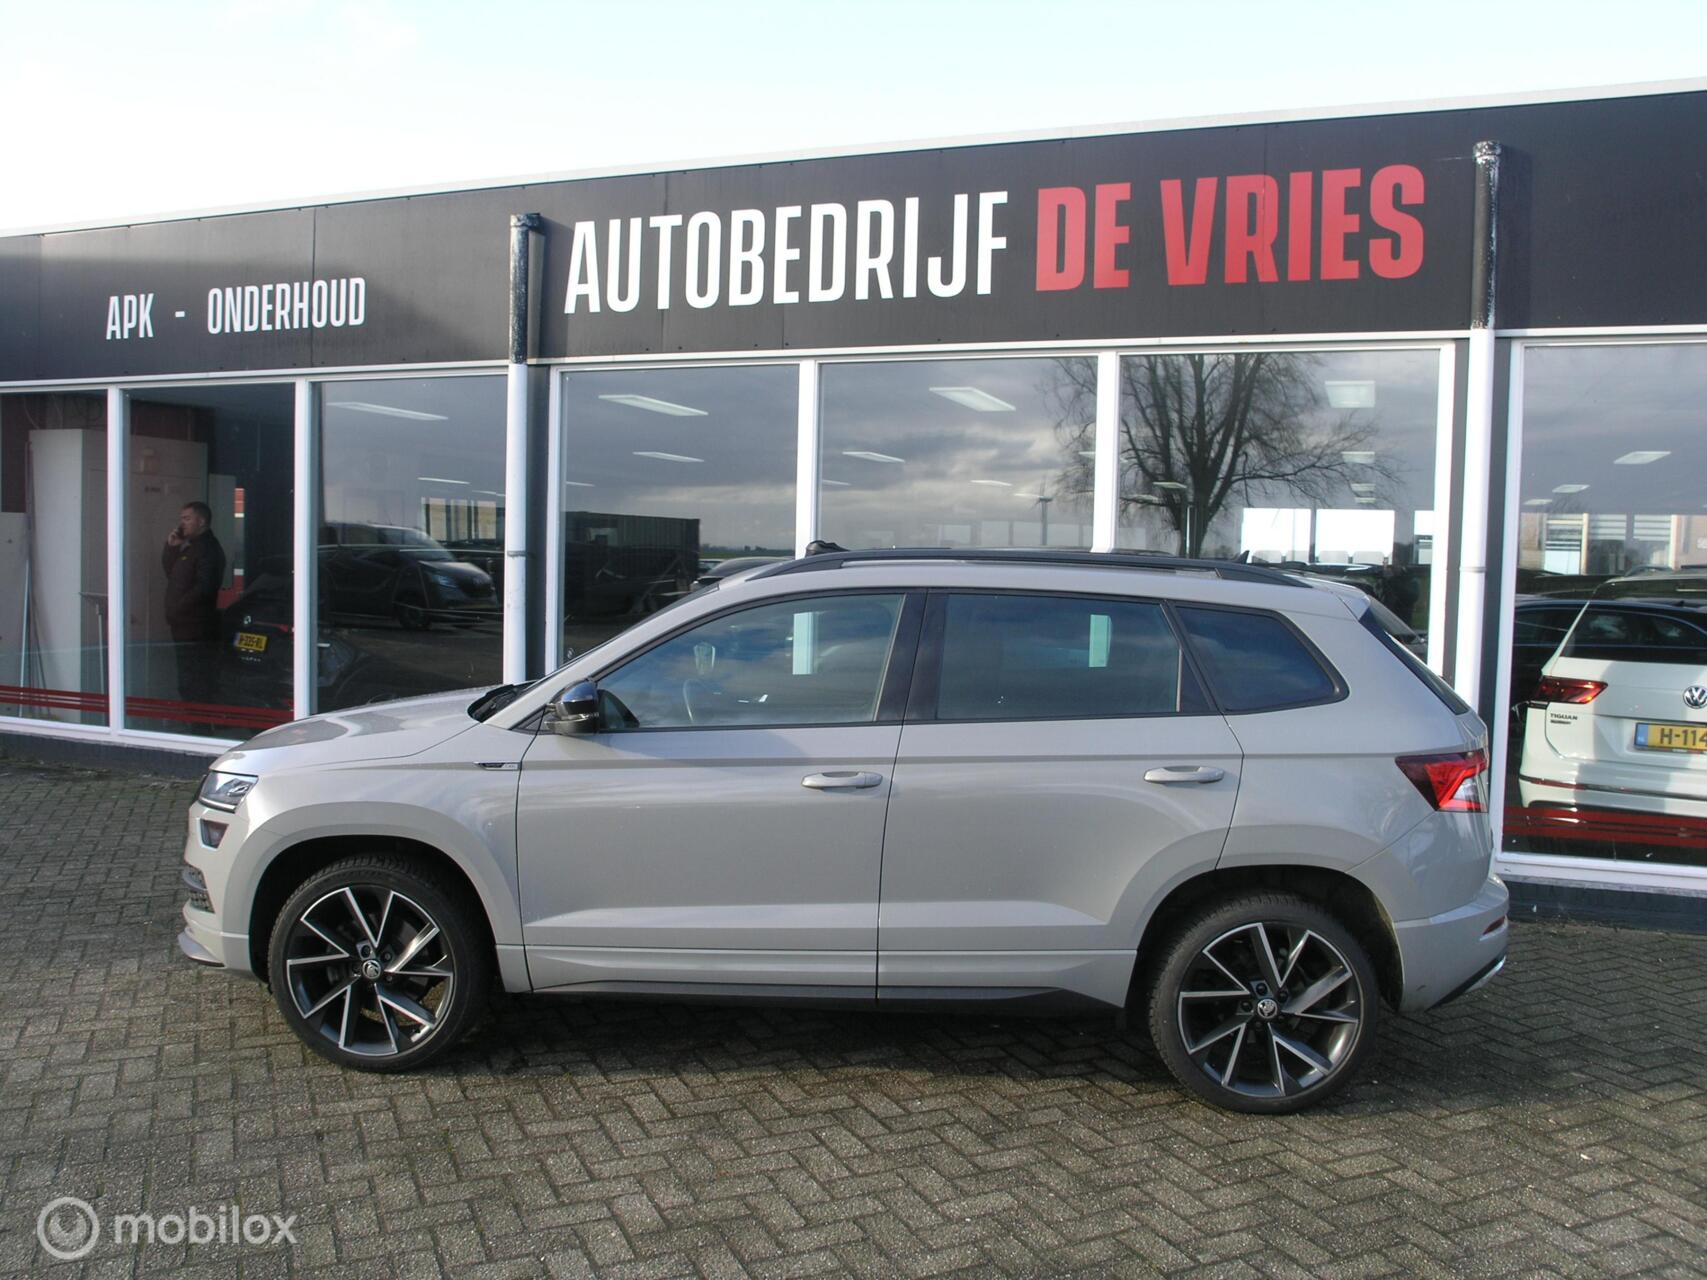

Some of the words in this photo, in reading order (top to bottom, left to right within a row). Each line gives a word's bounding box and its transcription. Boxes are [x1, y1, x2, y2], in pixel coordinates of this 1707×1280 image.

[564, 191, 1008, 314] AUTOBEDRIJF
[1036, 182, 1131, 291] DE
[1160, 164, 1425, 285] VRIES
[106, 293, 154, 340] APK
[207, 277, 366, 334] ONDERHOUD
